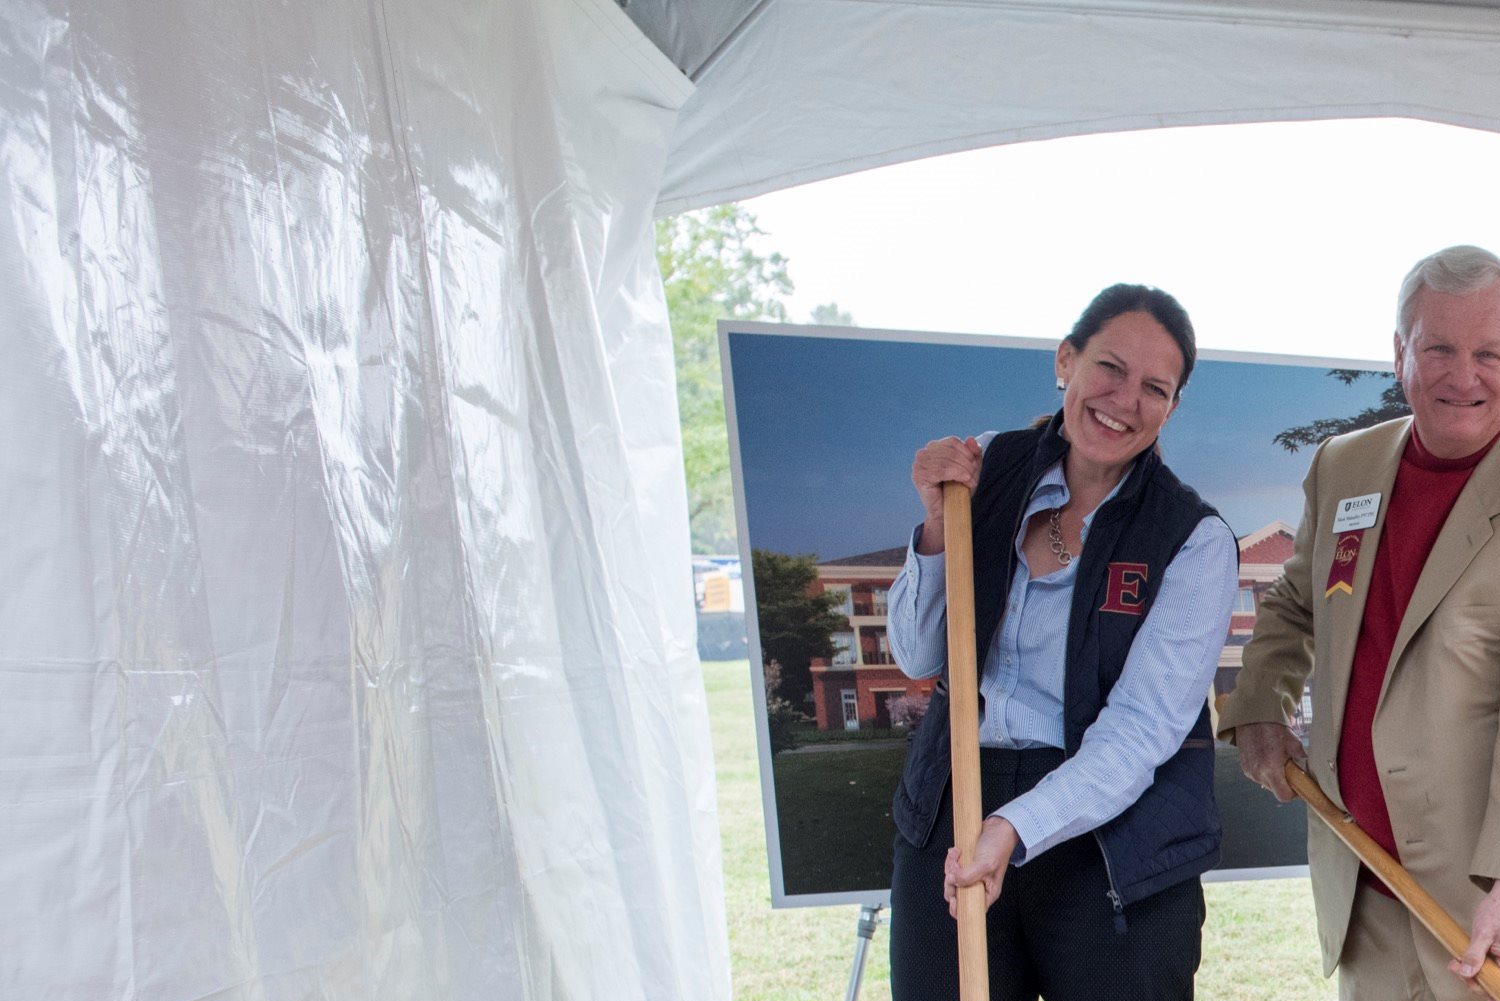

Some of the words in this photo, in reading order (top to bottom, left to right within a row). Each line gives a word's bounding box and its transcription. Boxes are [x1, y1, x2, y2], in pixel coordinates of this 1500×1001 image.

[1352, 498, 1372, 508] ELON
[1335, 549, 1356, 560] ELON
[1099, 562, 1148, 615] E
